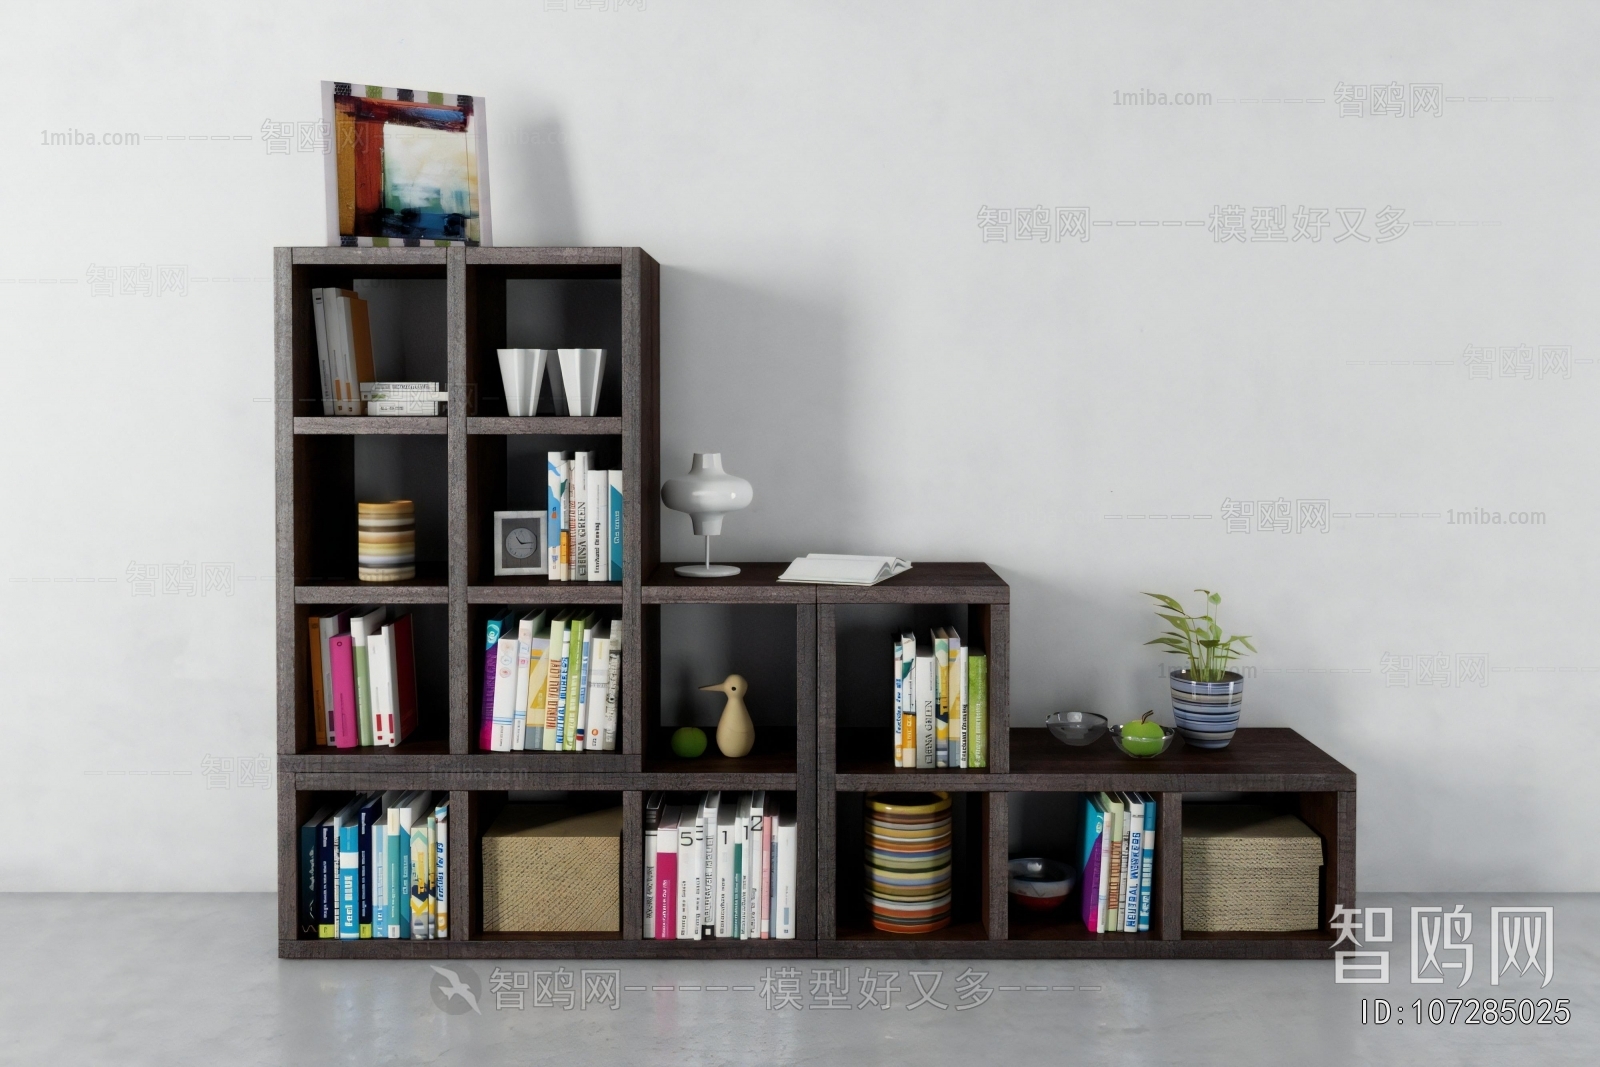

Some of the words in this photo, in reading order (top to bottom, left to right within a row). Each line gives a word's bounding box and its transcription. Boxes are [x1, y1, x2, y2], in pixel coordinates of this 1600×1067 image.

[750, 815, 763, 831] 2
[680, 831, 694, 847] 5
[722, 830, 728, 845] 1
[743, 825, 749, 840] 1
